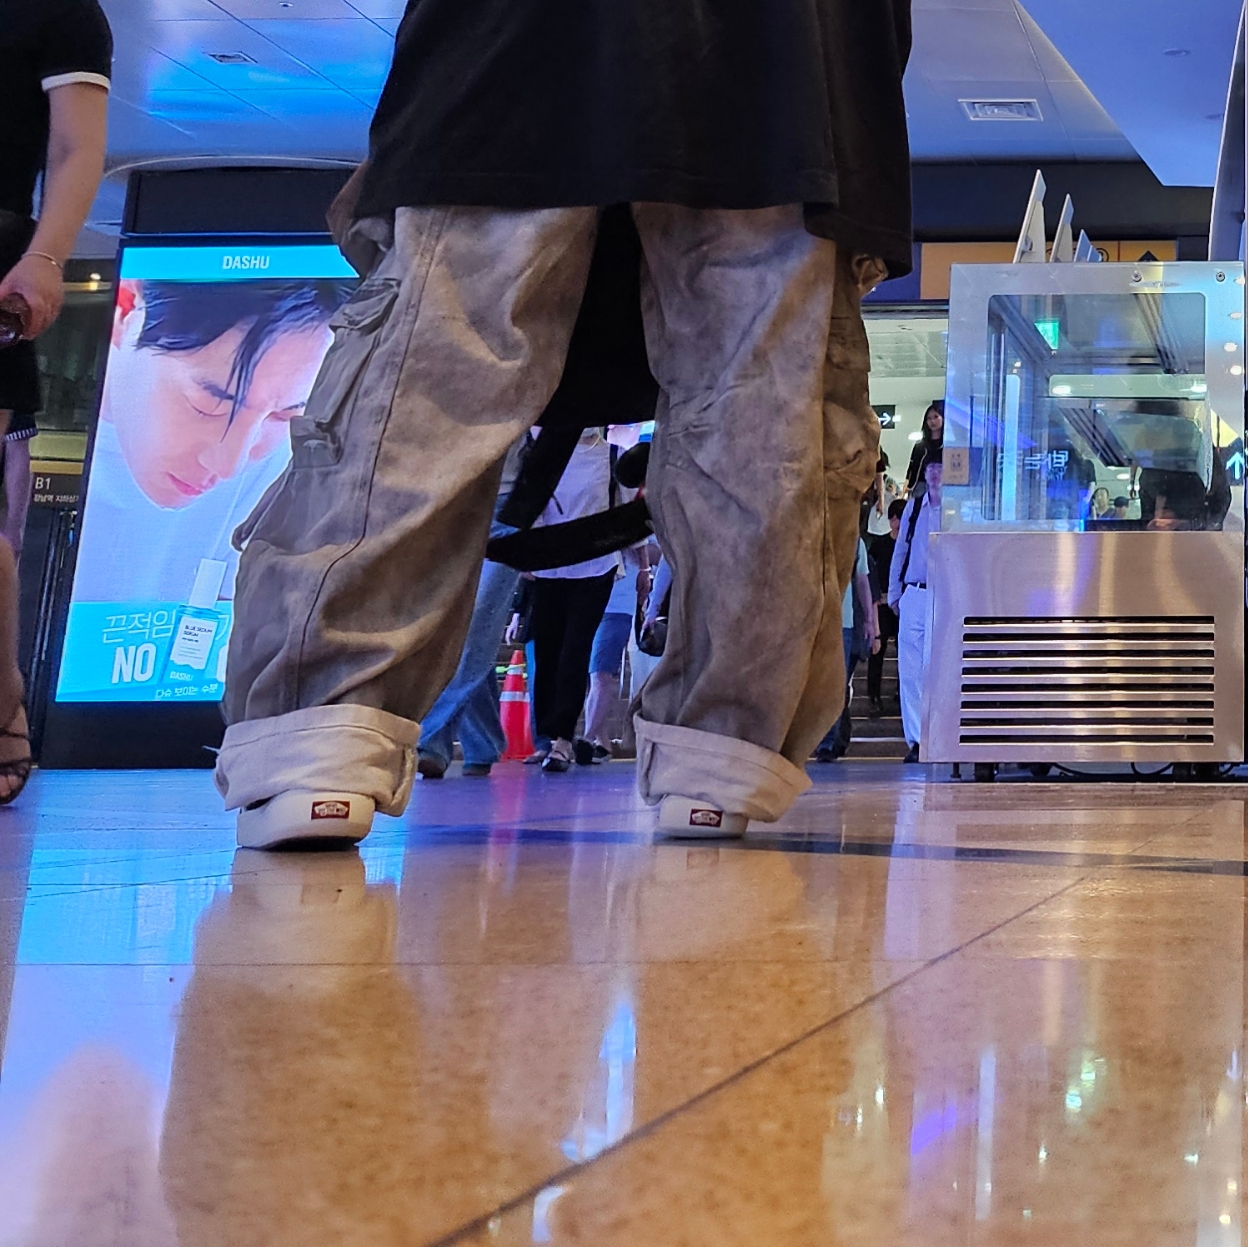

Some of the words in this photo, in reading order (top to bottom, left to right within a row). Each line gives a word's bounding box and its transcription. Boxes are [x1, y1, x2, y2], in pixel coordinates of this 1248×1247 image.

[222, 255, 270, 269] DASHU
[35, 476, 51, 490] B1
[102, 609, 176, 644] 끈적임
[111, 642, 157, 683] NO
